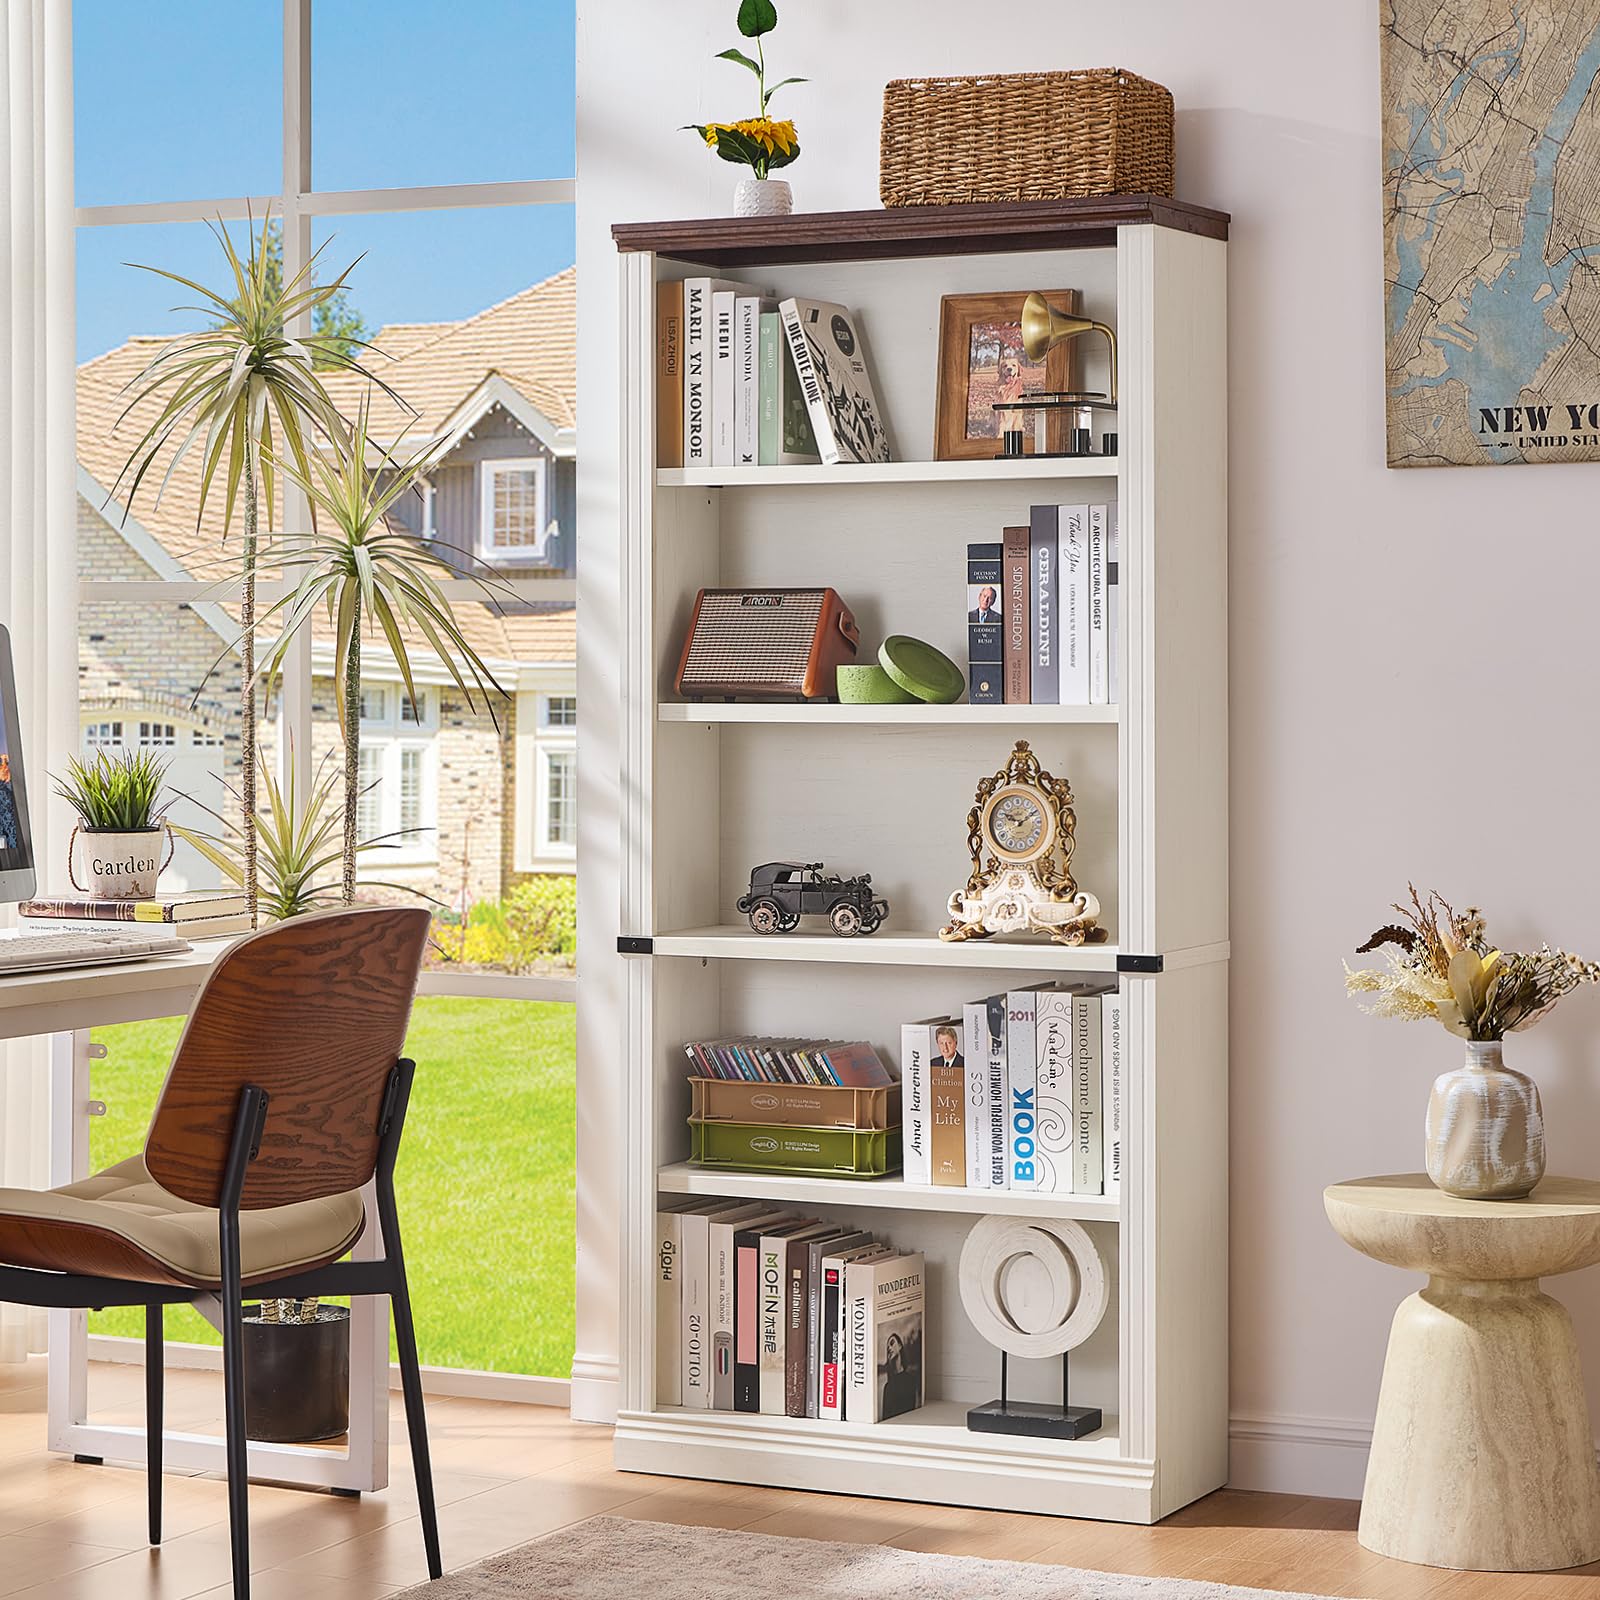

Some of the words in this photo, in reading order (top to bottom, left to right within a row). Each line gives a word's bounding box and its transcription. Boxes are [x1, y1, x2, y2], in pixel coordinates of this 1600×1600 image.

[667, 319, 676, 342] LISA
[690, 288, 702, 345] MARIL
[787, 321, 803, 343] DIE
[667, 343, 676, 373] ZHOU
[690, 351, 702, 376] YN
[793, 342, 812, 374] ROTE
[802, 373, 822, 405] ZONE
[690, 382, 702, 458] MONROE
[1479, 405, 1553, 433] NEW
[1519, 435, 1568, 448] UNITED
[1572, 434, 1600, 446] STA
[742, 453, 753, 463] K
[1068, 513, 1083, 548] Thank
[1092, 511, 1101, 522] AD
[1063, 545, 1082, 574] You
[1092, 525, 1102, 597] ARCHITECTURAL
[1012, 566, 1023, 602] SIDNEY
[1012, 602, 1023, 651] SHELDON
[1092, 598, 1102, 631] DIGEST
[92, 855, 155, 876] Garden
[1009, 1010, 1034, 1021] 2011
[1112, 1008, 1120, 1031] BAGS
[1048, 1022, 1057, 1089] Madame
[1078, 1003, 1093, 1106] monochrome
[1112, 1031, 1120, 1050] AND
[1112, 1051, 1120, 1077] SHOES
[909, 1050, 921, 1112] karenina
[931, 1078, 962, 1087] Clinton
[971, 1072, 984, 1107] COS
[989, 1061, 1002, 1102] HOMELIFE
[935, 1112, 961, 1125] Life
[937, 1095, 958, 1111] My
[910, 1119, 922, 1157] Anna
[990, 1103, 1004, 1154] WONDERFUL
[1012, 1087, 1035, 1182] BOOK
[1079, 1110, 1094, 1154] home
[990, 1156, 1004, 1186] CREATE
[658, 1240, 672, 1281] PHOTO
[877, 1274, 921, 1295] WONDERFUL
[688, 1314, 701, 1387] FOLIO-02
[853, 1297, 865, 1389] WONDERFUL
[825, 1367, 834, 1404] OLIVIA
